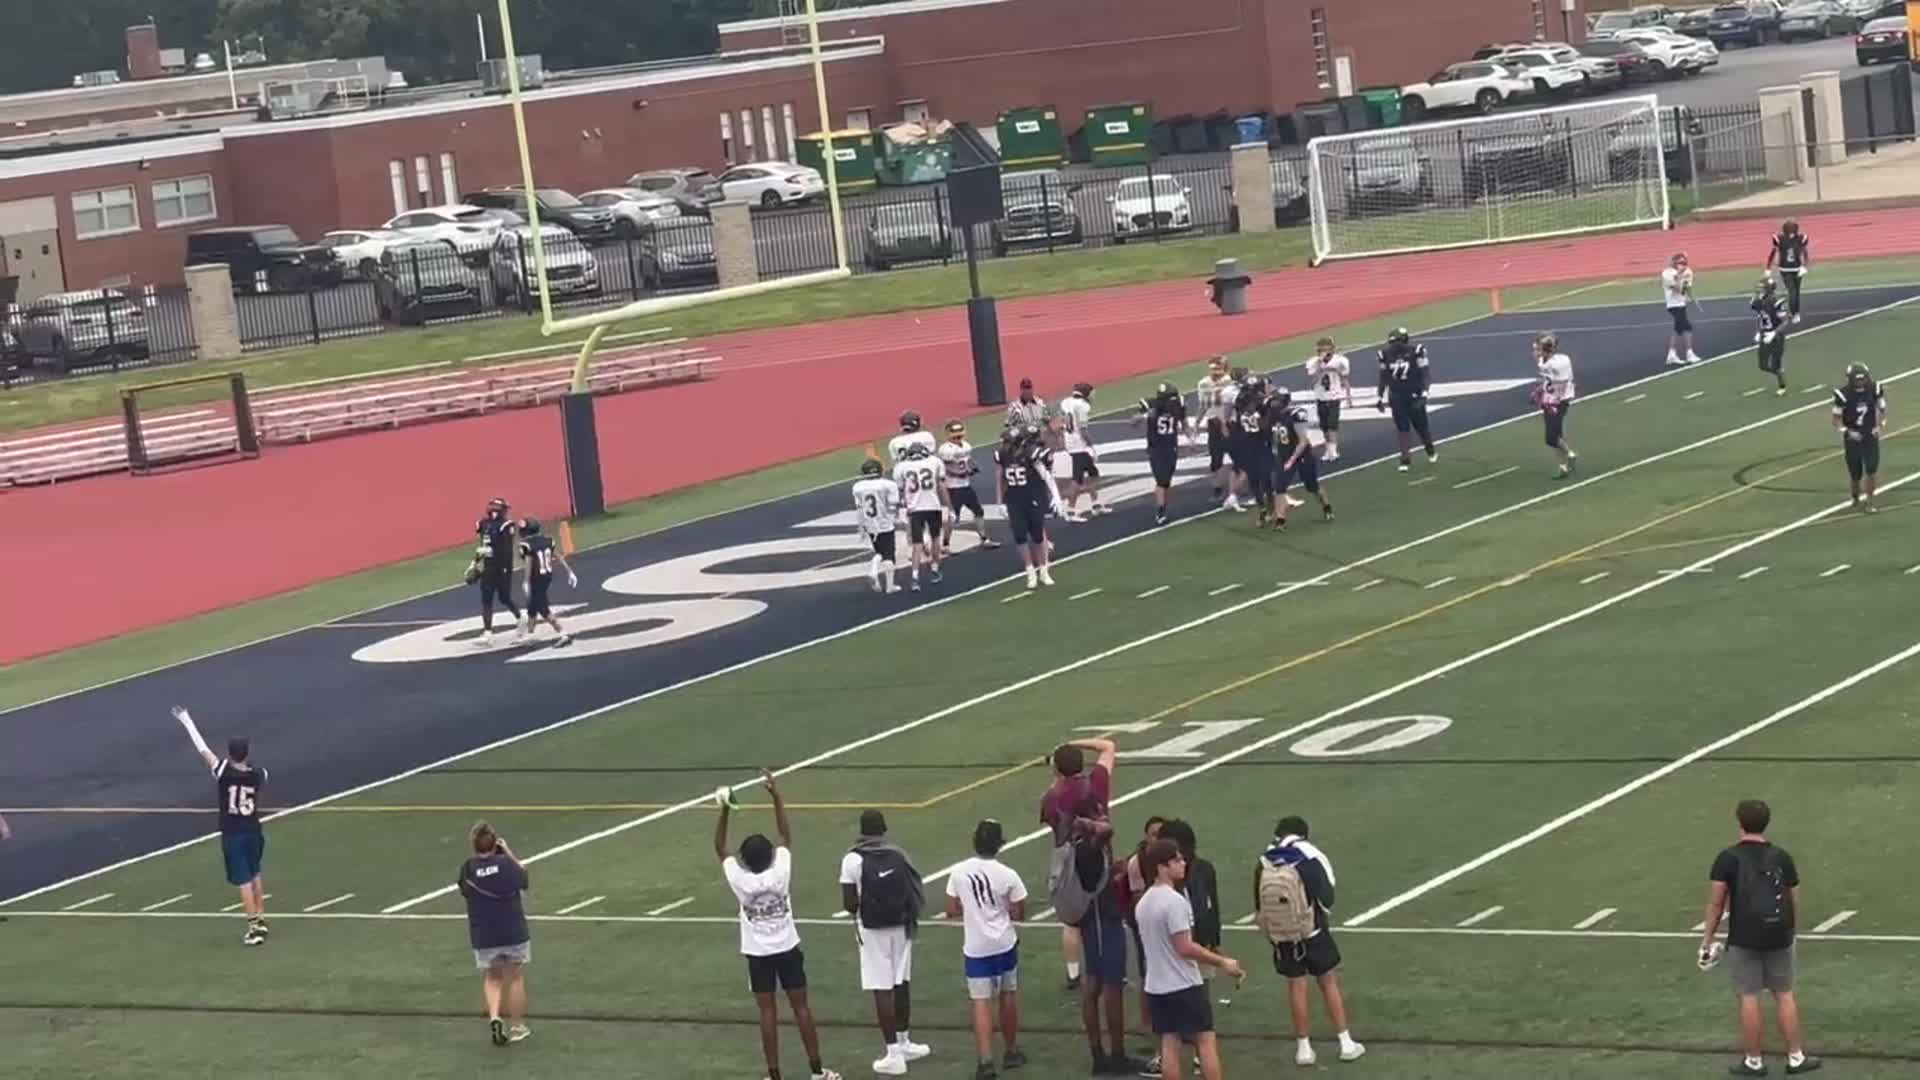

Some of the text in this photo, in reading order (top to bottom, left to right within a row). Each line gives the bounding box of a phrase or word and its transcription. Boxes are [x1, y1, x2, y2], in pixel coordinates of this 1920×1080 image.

[1389, 360, 1411, 381] 77
[1320, 373, 1331, 392] 4
[1157, 416, 1175, 435] 51
[1855, 404, 1869, 426] 7
[905, 467, 934, 493] 32
[1005, 466, 1027, 486] 55
[865, 493, 877, 518] 3
[1110, 714, 1453, 758] 10
[228, 784, 256, 817] 15
